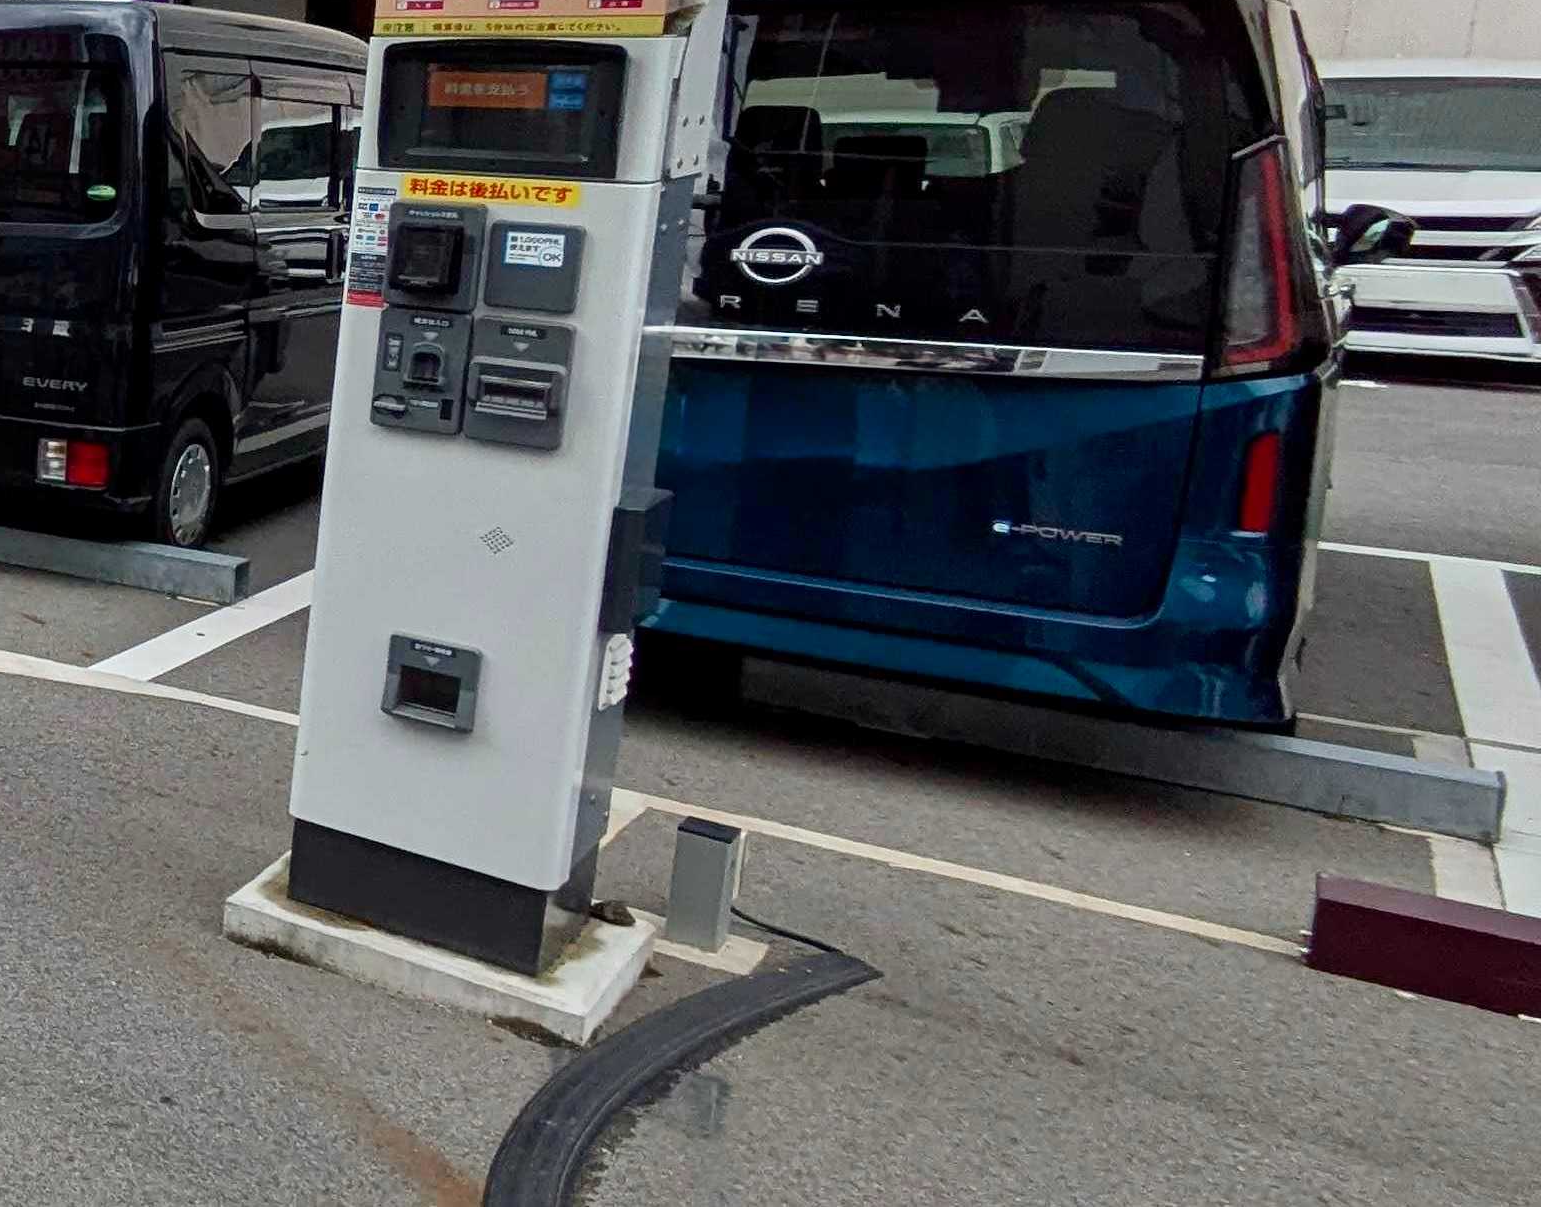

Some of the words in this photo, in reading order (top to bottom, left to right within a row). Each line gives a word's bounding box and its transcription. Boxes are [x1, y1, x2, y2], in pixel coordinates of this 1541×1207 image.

[409, 177, 573, 203] 料金は後払いです
[731, 249, 822, 265] NISSAN
[22, 376, 89, 392] EVERY
[991, 520, 1124, 546] e-POWER
